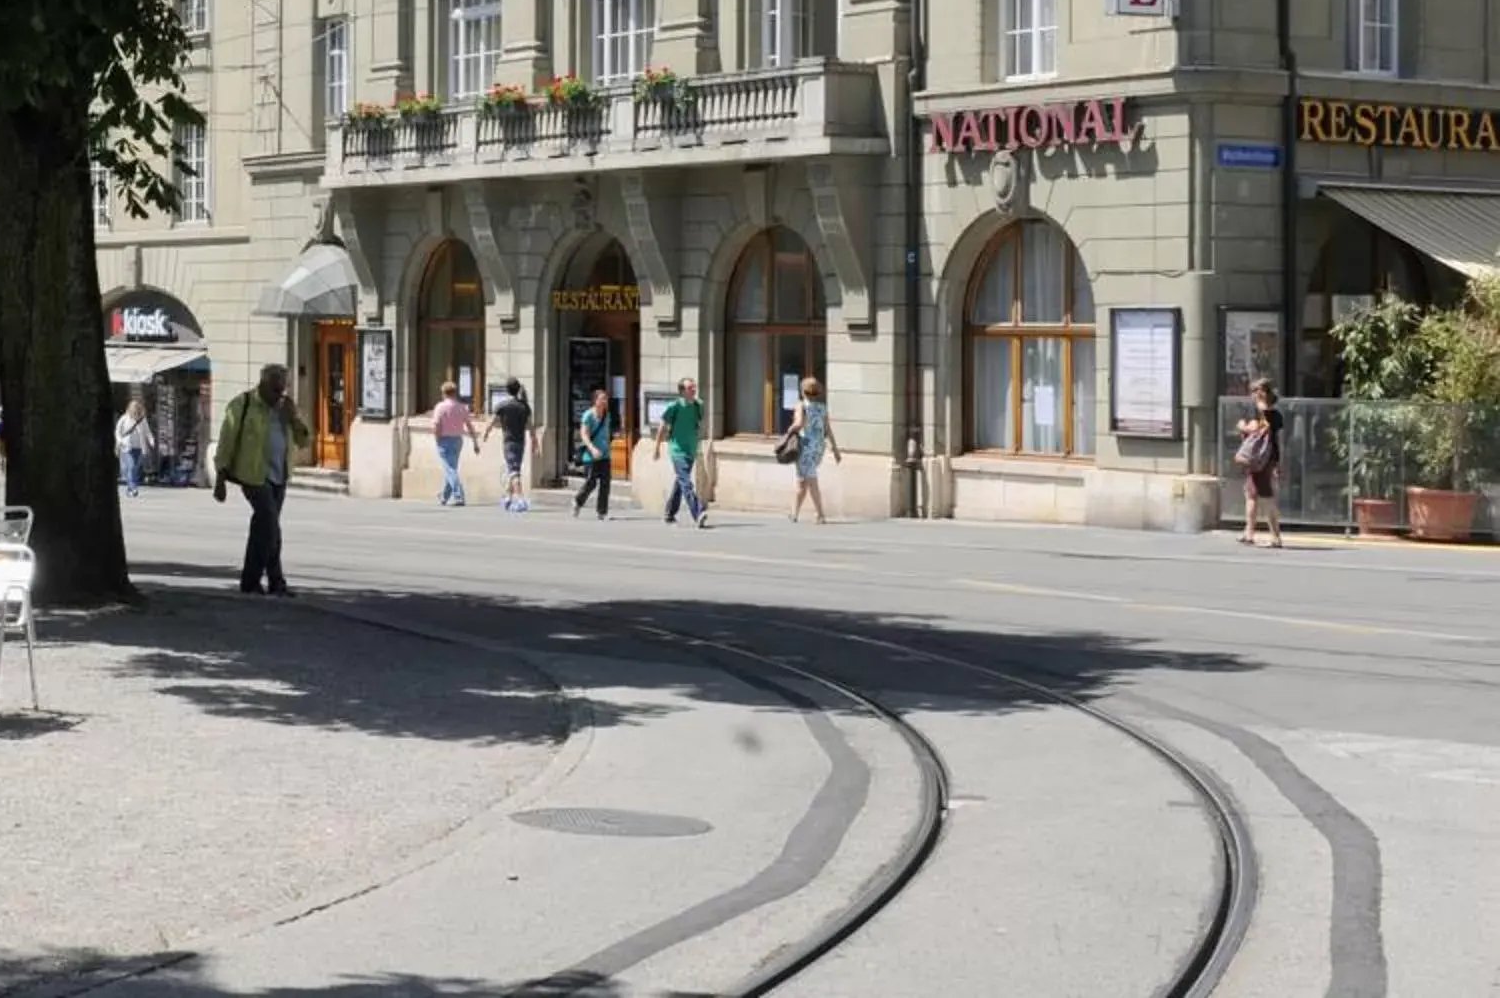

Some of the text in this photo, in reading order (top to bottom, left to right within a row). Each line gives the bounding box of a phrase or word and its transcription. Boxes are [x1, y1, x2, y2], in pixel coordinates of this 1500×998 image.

[930, 97, 1138, 153] NATIONAL
[1302, 100, 1500, 150] RESTAURA
[123, 307, 168, 335] kiosk
